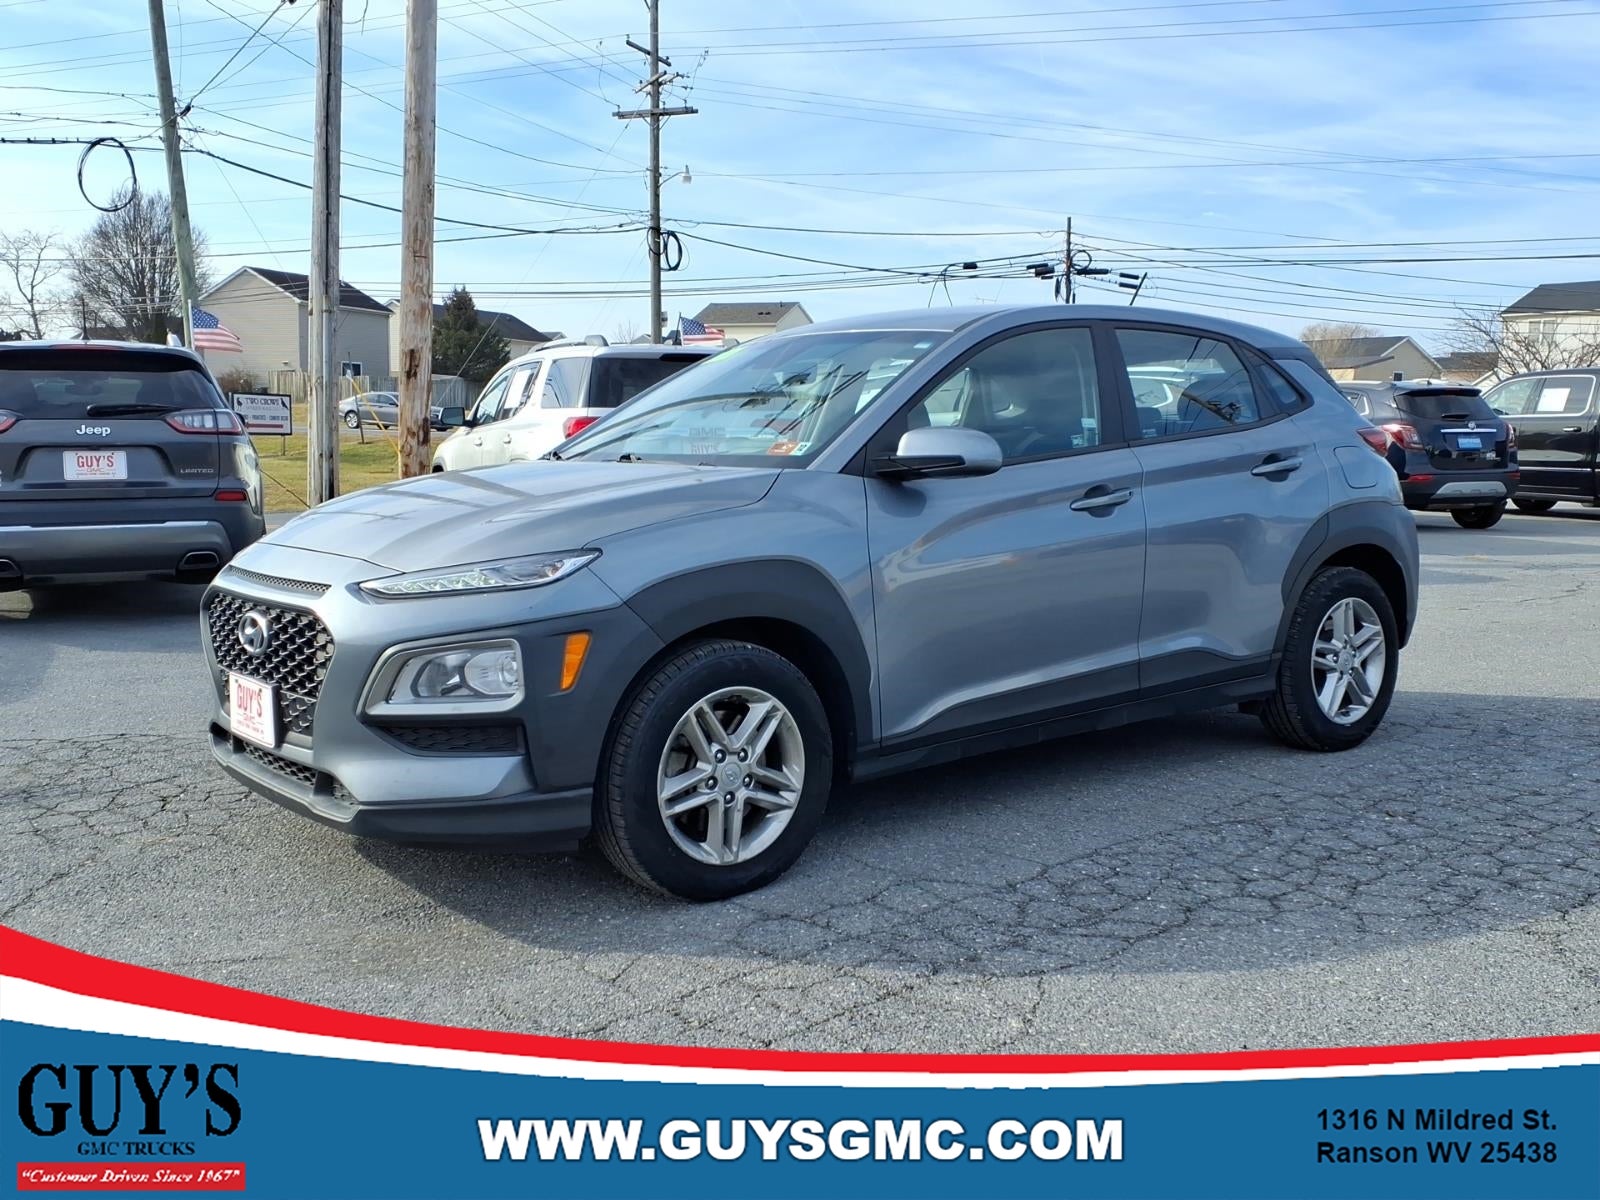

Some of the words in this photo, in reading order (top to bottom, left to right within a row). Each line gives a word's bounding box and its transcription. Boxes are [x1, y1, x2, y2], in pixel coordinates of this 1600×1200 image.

[76, 424, 111, 437] Jeep
[76, 455, 114, 468] GUY'S
[236, 683, 263, 719] GUY'S
